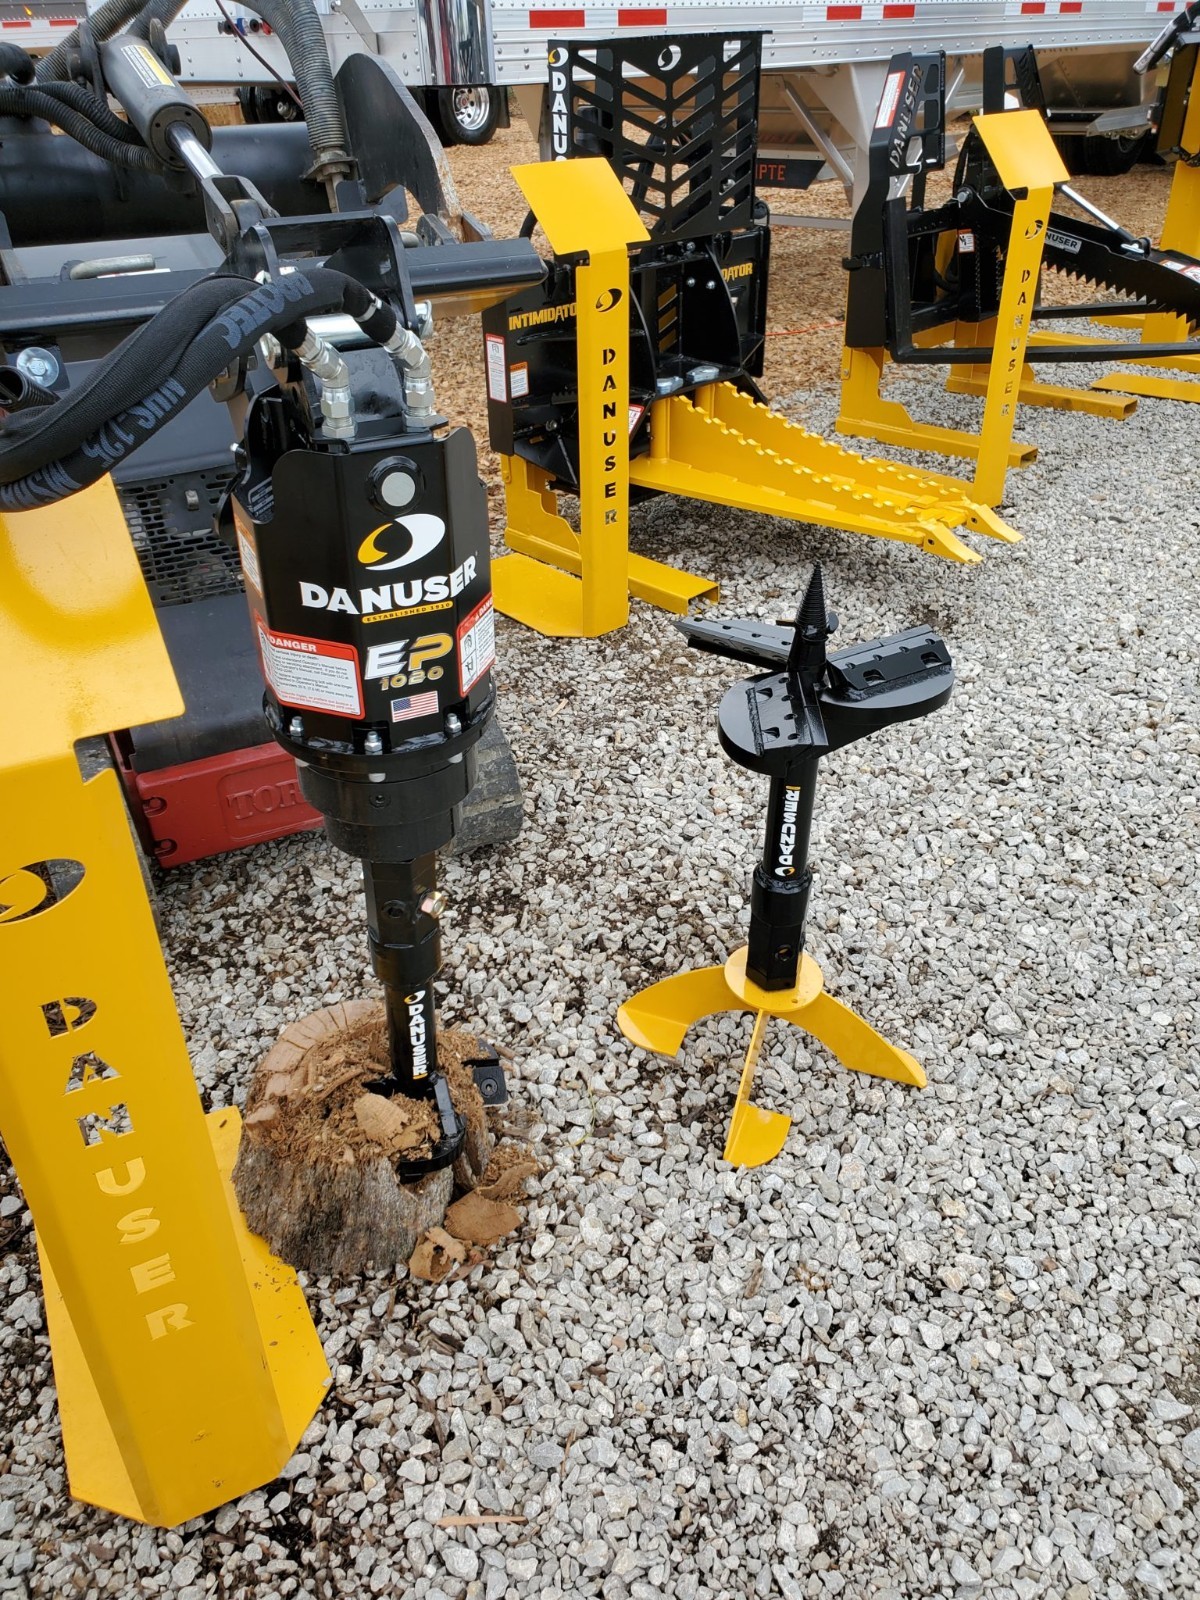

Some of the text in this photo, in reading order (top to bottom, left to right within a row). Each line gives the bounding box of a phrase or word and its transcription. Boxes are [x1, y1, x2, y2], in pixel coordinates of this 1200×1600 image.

[552, 71, 569, 161] DANU
[756, 163, 786, 181] PTE
[1046, 231, 1078, 249] NUSER
[721, 262, 753, 282] DATOR
[508, 302, 577, 331] INTIMIDATO
[1001, 269, 1030, 416] DANUSER
[602, 348, 618, 525] DANUSER
[298, 555, 477, 615] DANUSER
[366, 602, 451, 622] ESTABLISHED 1910
[269, 637, 317, 653] DANGER
[364, 632, 454, 680] EP
[379, 665, 444, 691] 1020
[226, 778, 300, 820] TOR
[778, 790, 800, 866] DANUSER
[408, 1003, 428, 1076] DANUSER
[40, 995, 197, 1341] DANUSER
